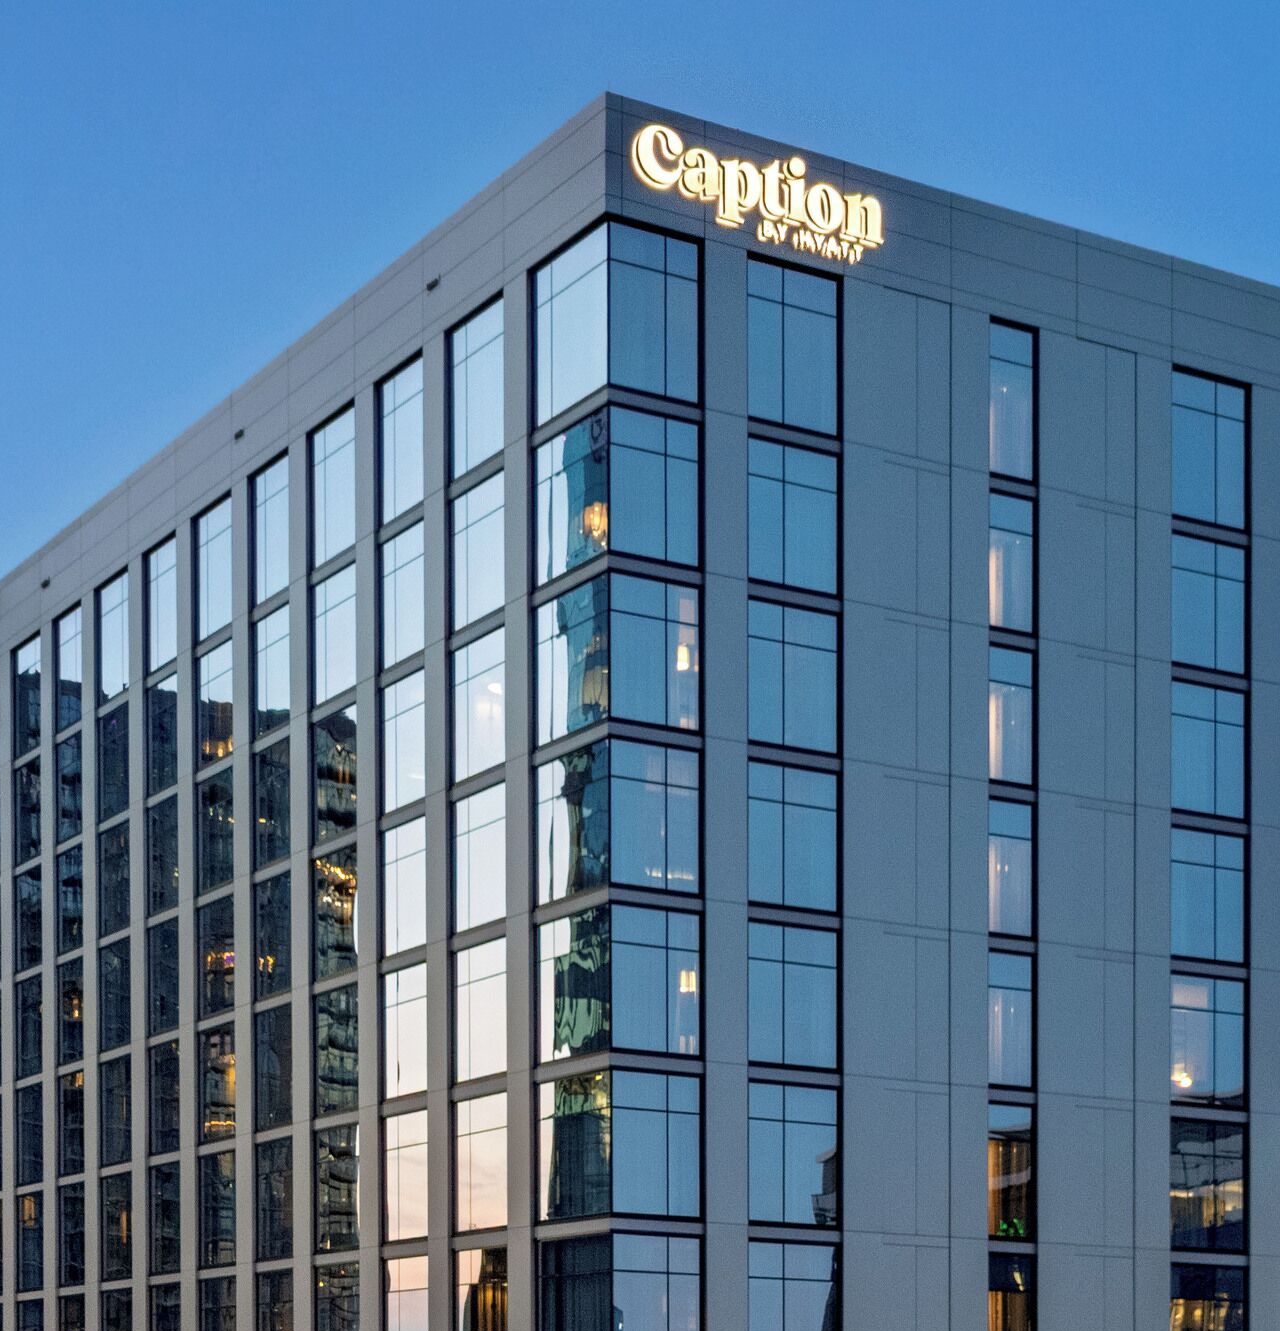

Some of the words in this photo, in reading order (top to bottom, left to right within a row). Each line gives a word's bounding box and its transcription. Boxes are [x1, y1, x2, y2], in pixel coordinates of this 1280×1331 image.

[631, 124, 884, 247] Caption
[757, 220, 788, 244] BY
[792, 228, 864, 265] HYATT
